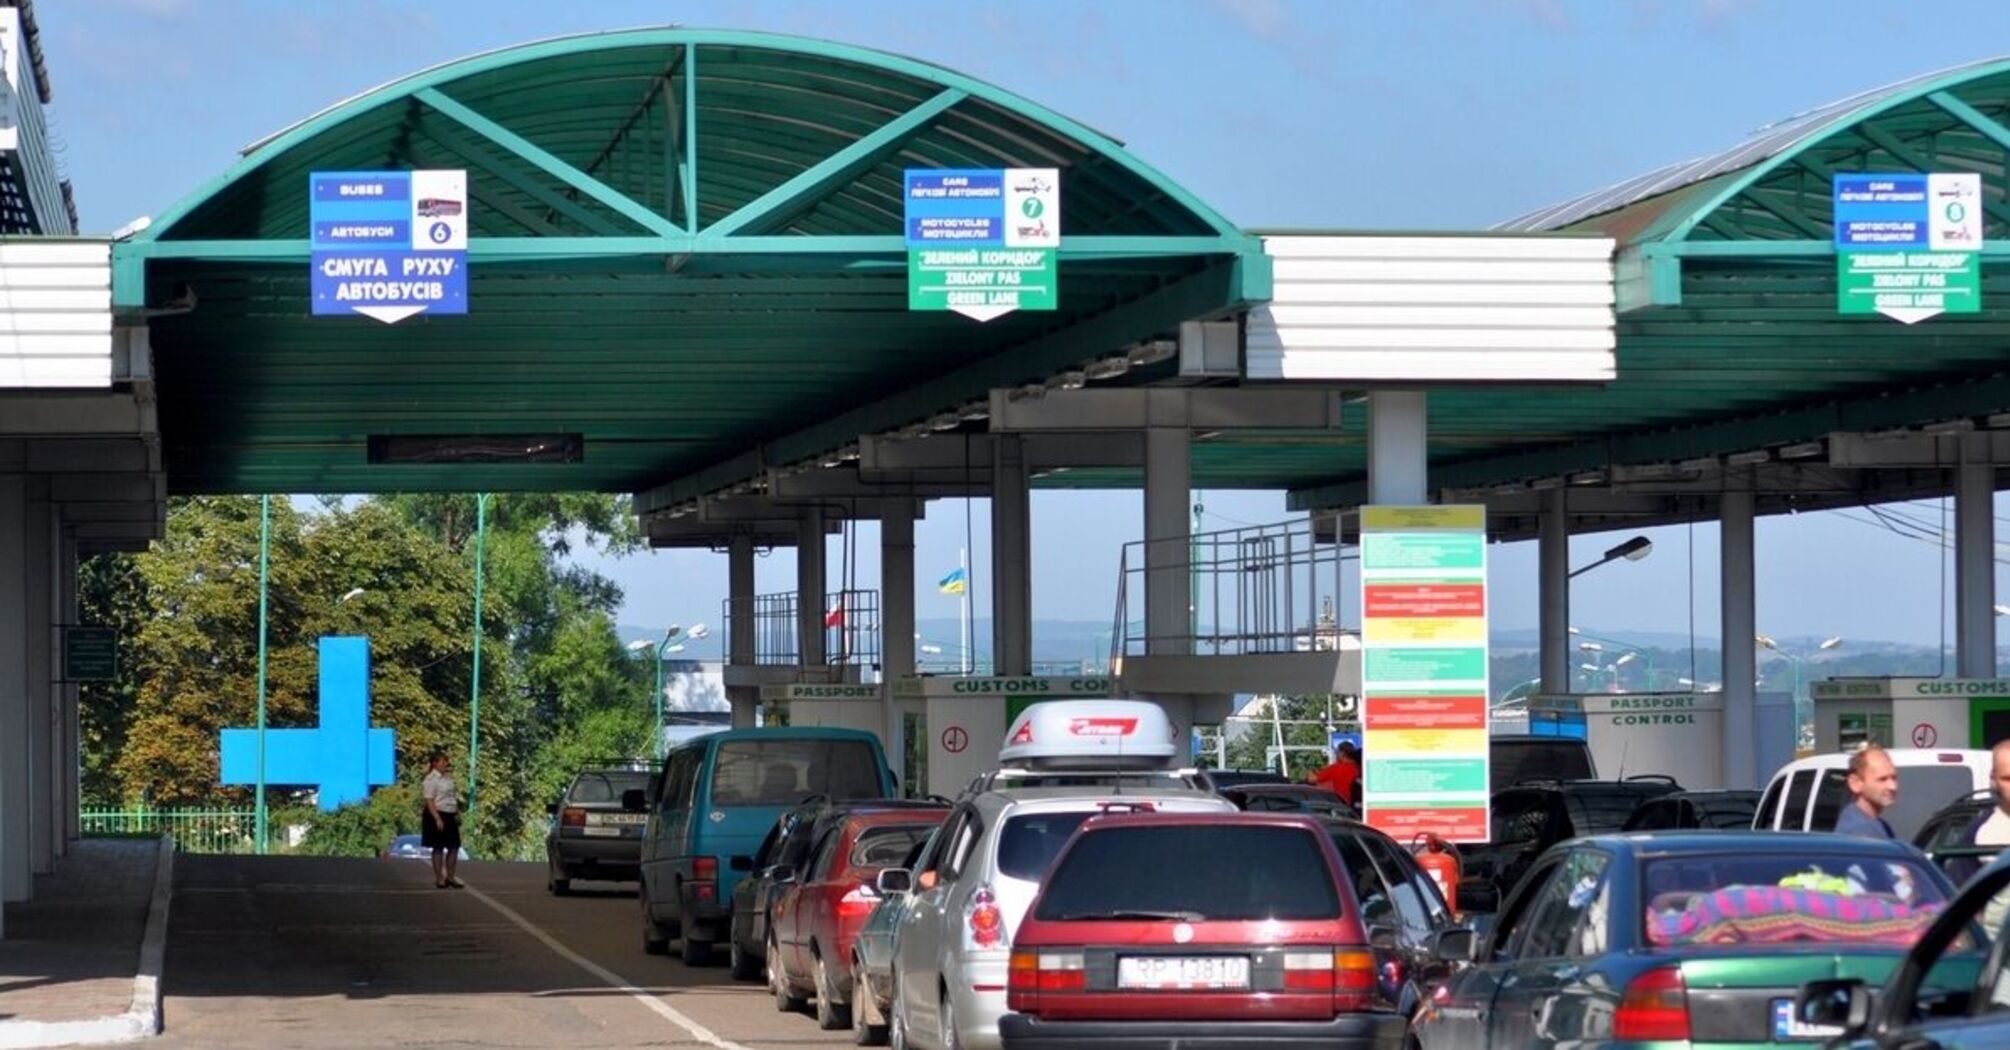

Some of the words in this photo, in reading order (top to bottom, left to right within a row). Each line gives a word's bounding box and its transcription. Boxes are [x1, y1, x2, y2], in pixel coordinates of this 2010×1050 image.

[942, 177, 968, 186] CARS
[339, 184, 384, 195] BUSES
[1027, 201, 1039, 215] 7
[921, 218, 990, 227] MOTOCYCLES
[330, 226, 394, 237] АВТОБУСИ
[434, 224, 446, 240] 6
[922, 229, 989, 238] МОТОЦИКЛИ
[323, 258, 388, 277] СМУГА
[402, 258, 454, 276] РУХУ
[945, 271, 993, 284] ZIELONY
[998, 271, 1020, 284] PAS
[1873, 273, 1920, 287] ZIELONY
[1922, 273, 1946, 287] PAS
[336, 282, 443, 300] АВТОБУСІВ
[947, 291, 985, 305] GREEN
[988, 291, 1019, 305] LANE
[793, 686, 876, 697] PASSPORT
[953, 680, 1049, 693] CUSTOMS
[1916, 682, 2010, 695] CUSTOMS
[1610, 697, 1695, 708] PASSPORT
[1612, 714, 1696, 726] CONTROL
